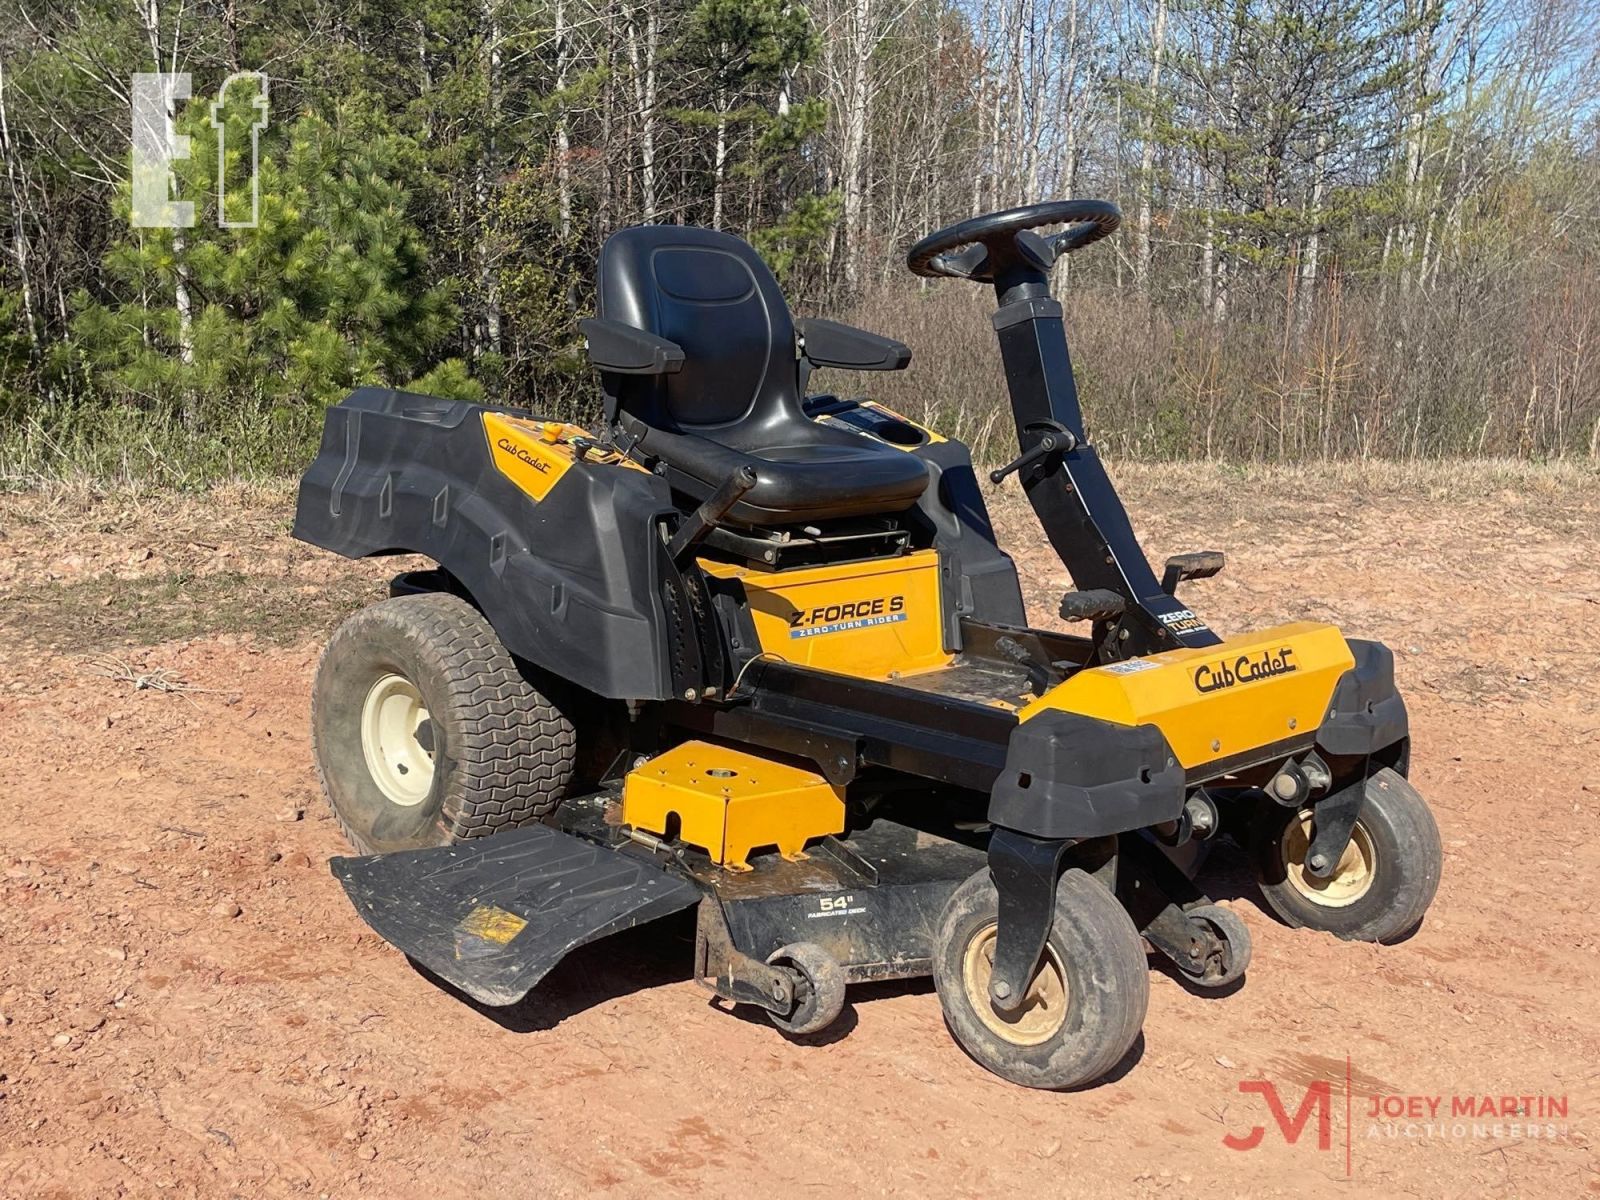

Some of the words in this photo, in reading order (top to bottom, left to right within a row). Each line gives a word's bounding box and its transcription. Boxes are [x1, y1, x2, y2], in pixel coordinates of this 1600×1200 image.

[497, 438, 517, 455] Cub
[517, 449, 551, 475] Cadet
[790, 598, 885, 628] Z-FORCE
[889, 595, 904, 612] S
[1158, 610, 1195, 623] ZERO
[799, 619, 862, 637] ZERO-TURN
[867, 614, 900, 626] RIDER
[1167, 618, 1205, 631] TURN
[1194, 661, 1235, 693] Cub
[1235, 647, 1297, 683] Cadet
[820, 896, 853, 910] 54"
[808, 910, 847, 918] FABRICATED
